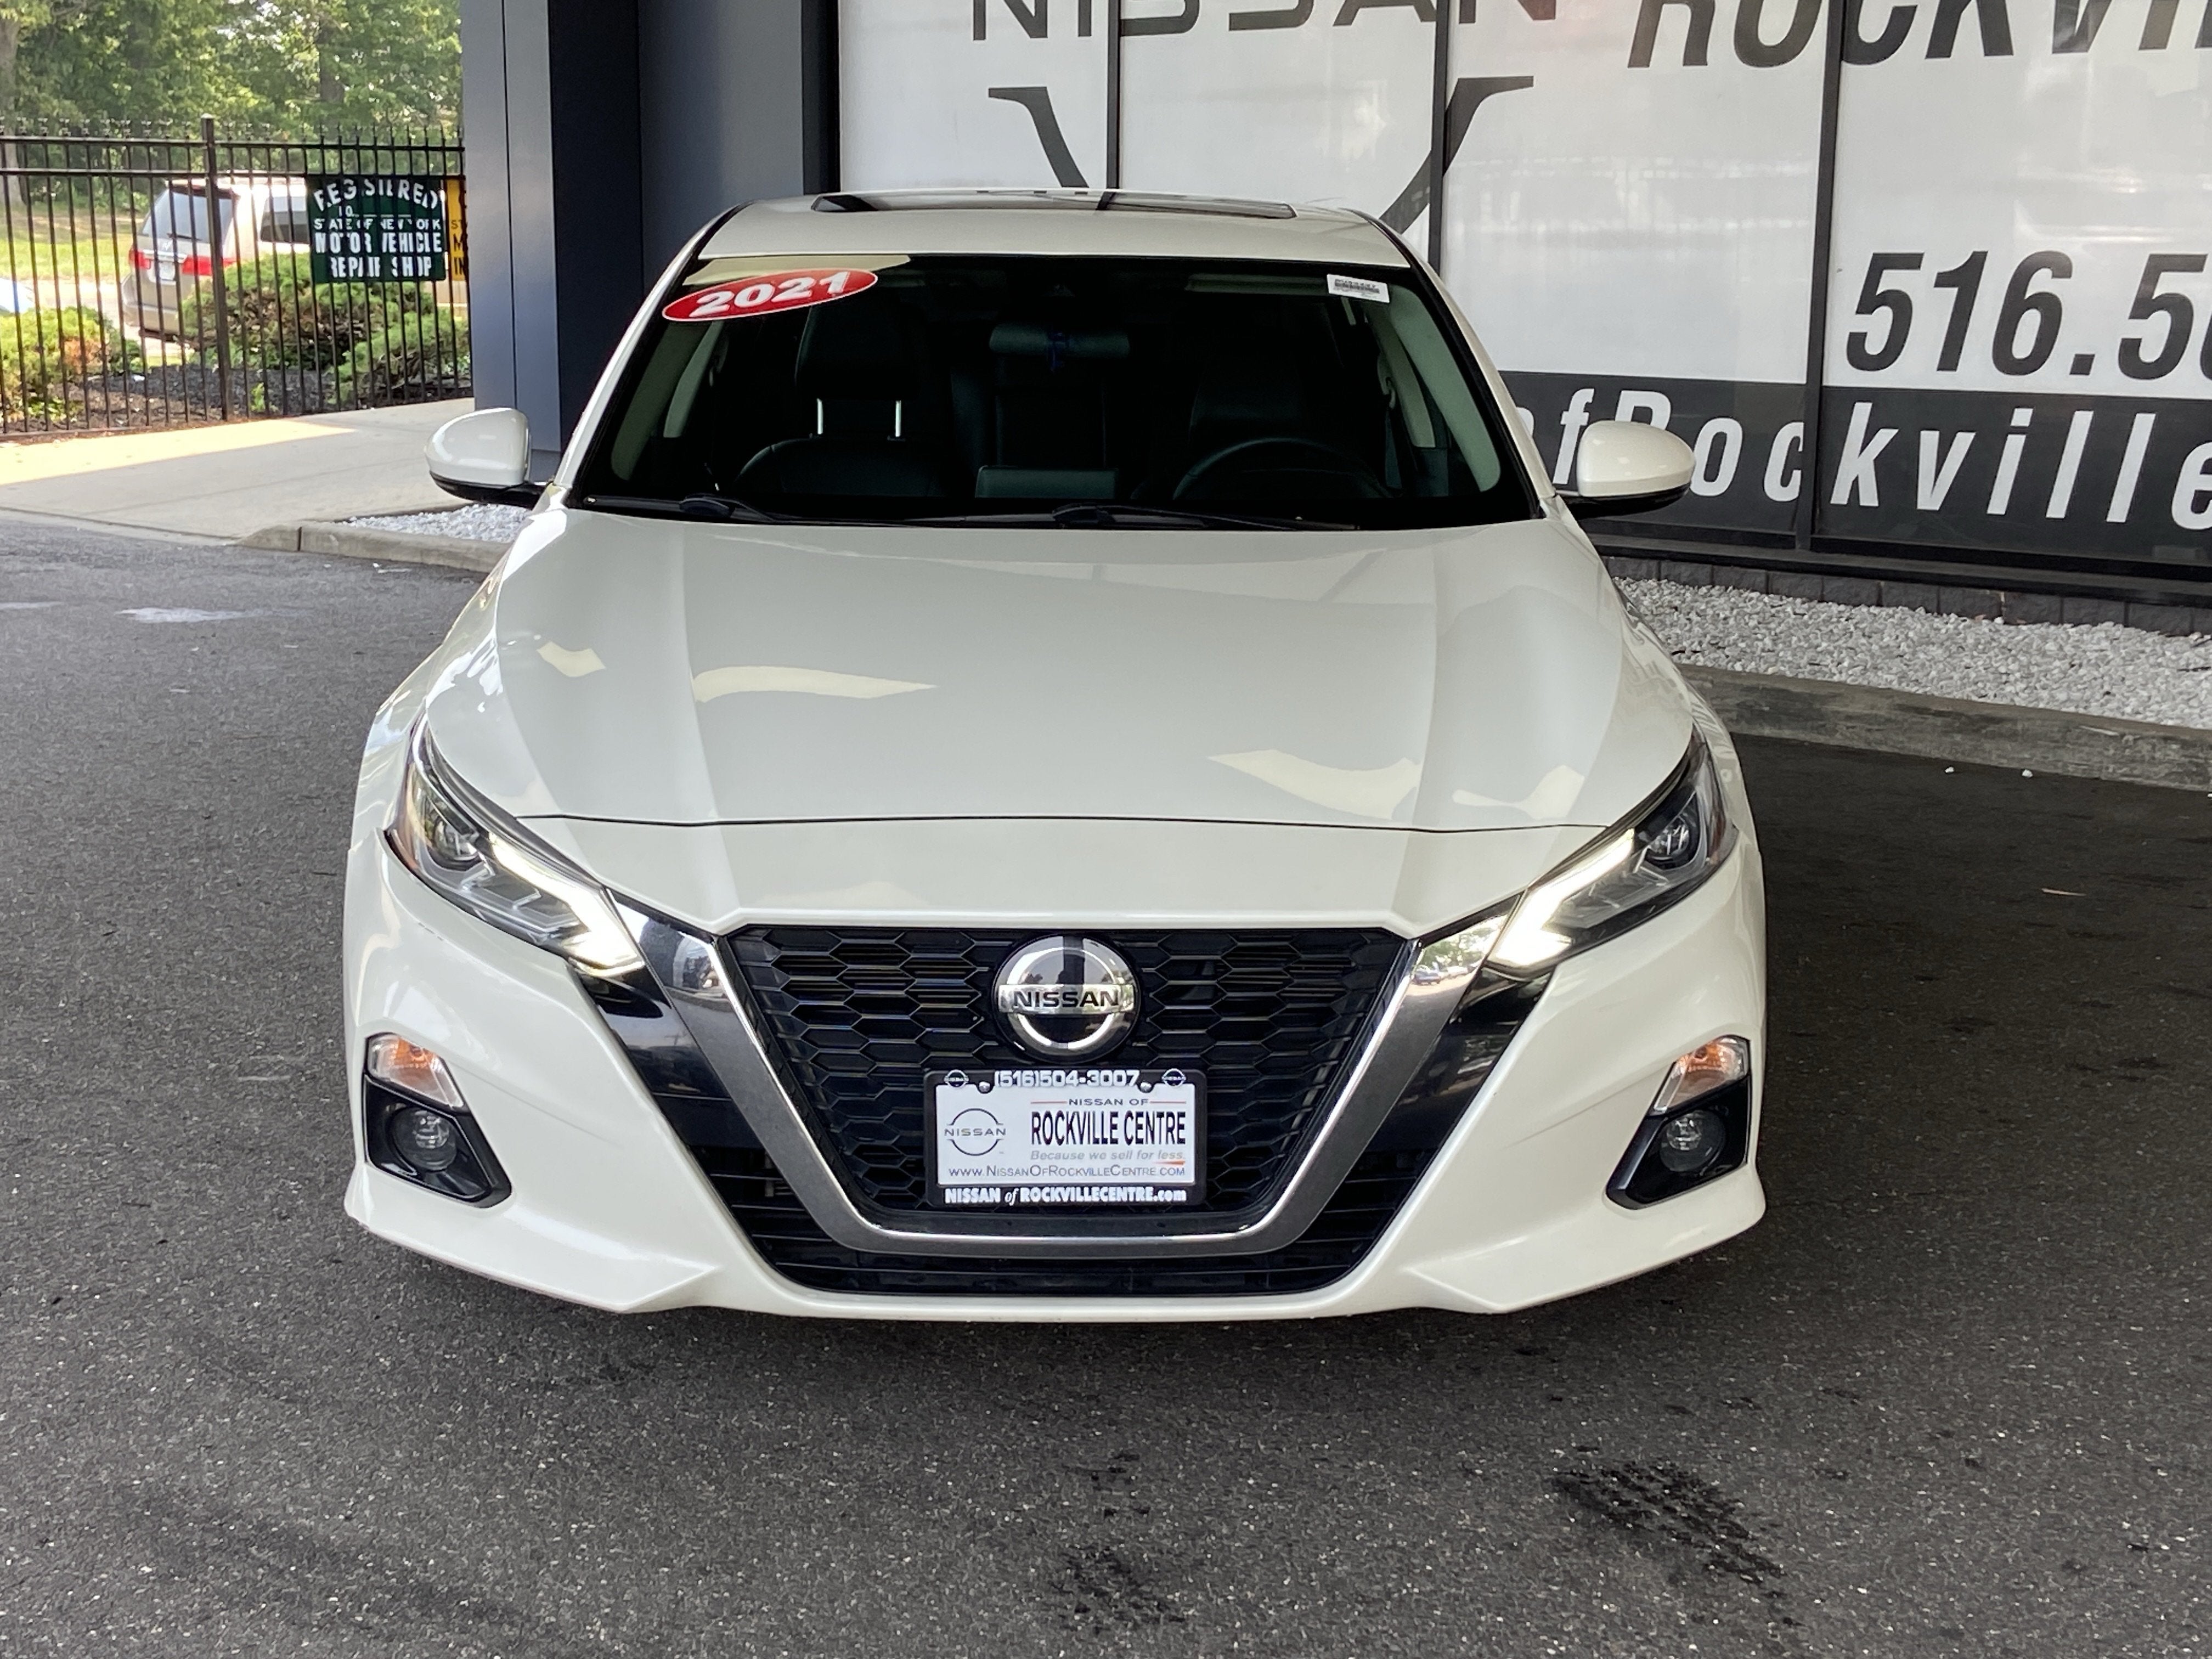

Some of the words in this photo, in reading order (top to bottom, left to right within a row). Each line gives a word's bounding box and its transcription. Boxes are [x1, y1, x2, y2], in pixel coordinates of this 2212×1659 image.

[315, 232, 373, 254] MOOR
[688, 271, 851, 318] 2021
[1846, 250, 2212, 380] 516.5
[1014, 990, 1119, 1008] NISSAN
[994, 1070, 1140, 1088] (516)504-3007
[944, 1128, 1006, 1136] NISSAN
[1031, 1110, 1118, 1146] ROCKVILLE
[1124, 1110, 1186, 1146] CENTRE
[1030, 1150, 1085, 1160] Because
[1111, 1150, 1133, 1160] sell
[1136, 1150, 1154, 1160] for
[1158, 1150, 1186, 1160] less.
[945, 1187, 1001, 1204] NISSAN
[1004, 1189, 1019, 1206] of
[1020, 1186, 1187, 1203] ROCKVILLECENTRE.com
